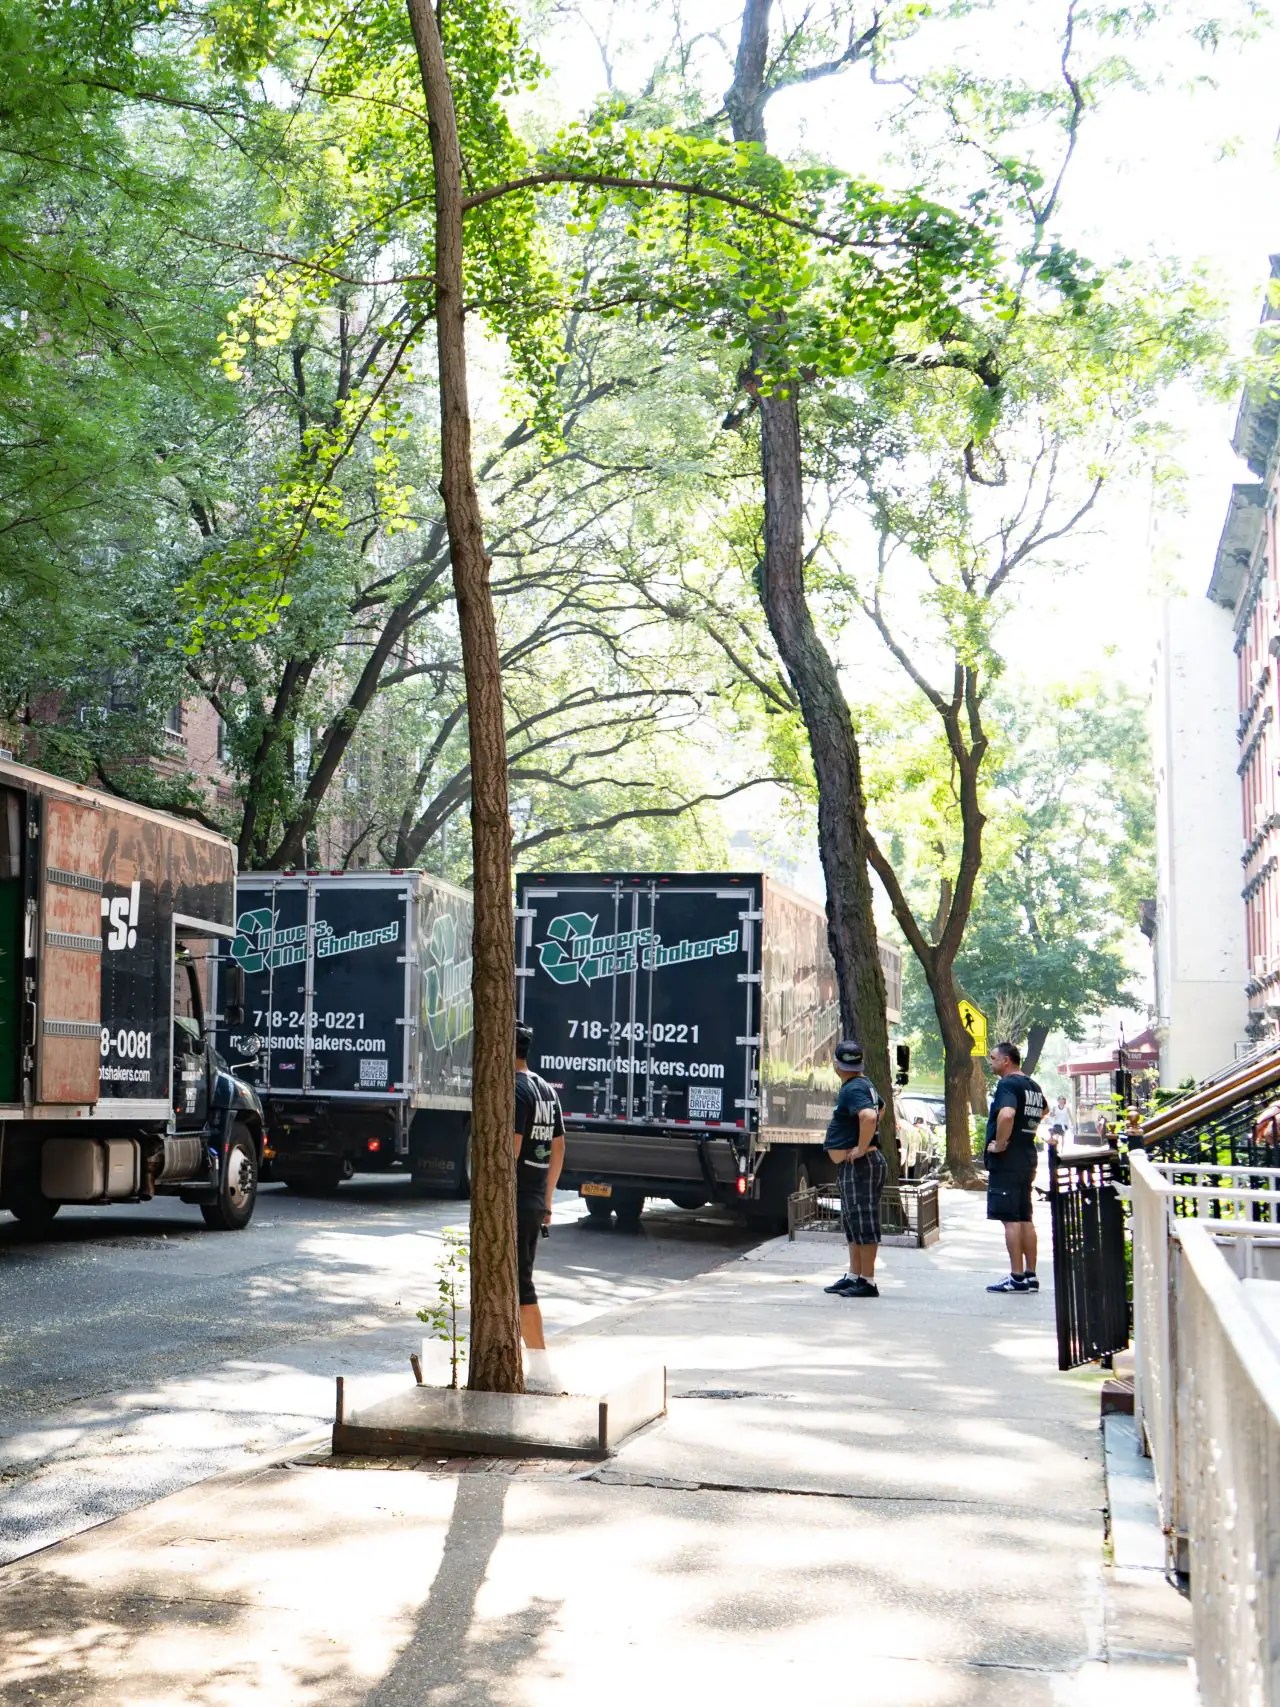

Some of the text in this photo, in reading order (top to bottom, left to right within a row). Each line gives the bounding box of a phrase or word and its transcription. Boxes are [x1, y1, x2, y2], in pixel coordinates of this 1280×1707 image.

[258, 920, 334, 950] Movers,
[317, 921, 399, 958] Shakers!
[572, 927, 661, 959] Movers,
[601, 930, 738, 976] Not Shakers!
[253, 1010, 365, 1030] 718-243-0221
[568, 1020, 699, 1044] 718-243-0221
[100, 1027, 151, 1059] 8-0081
[230, 1033, 386, 1052] mersnotshakers.com
[540, 1055, 725, 1079] moversnotshakers.com
[689, 1110, 721, 1119] GREAT PAY
[690, 1099, 721, 1110] DRIVERS
